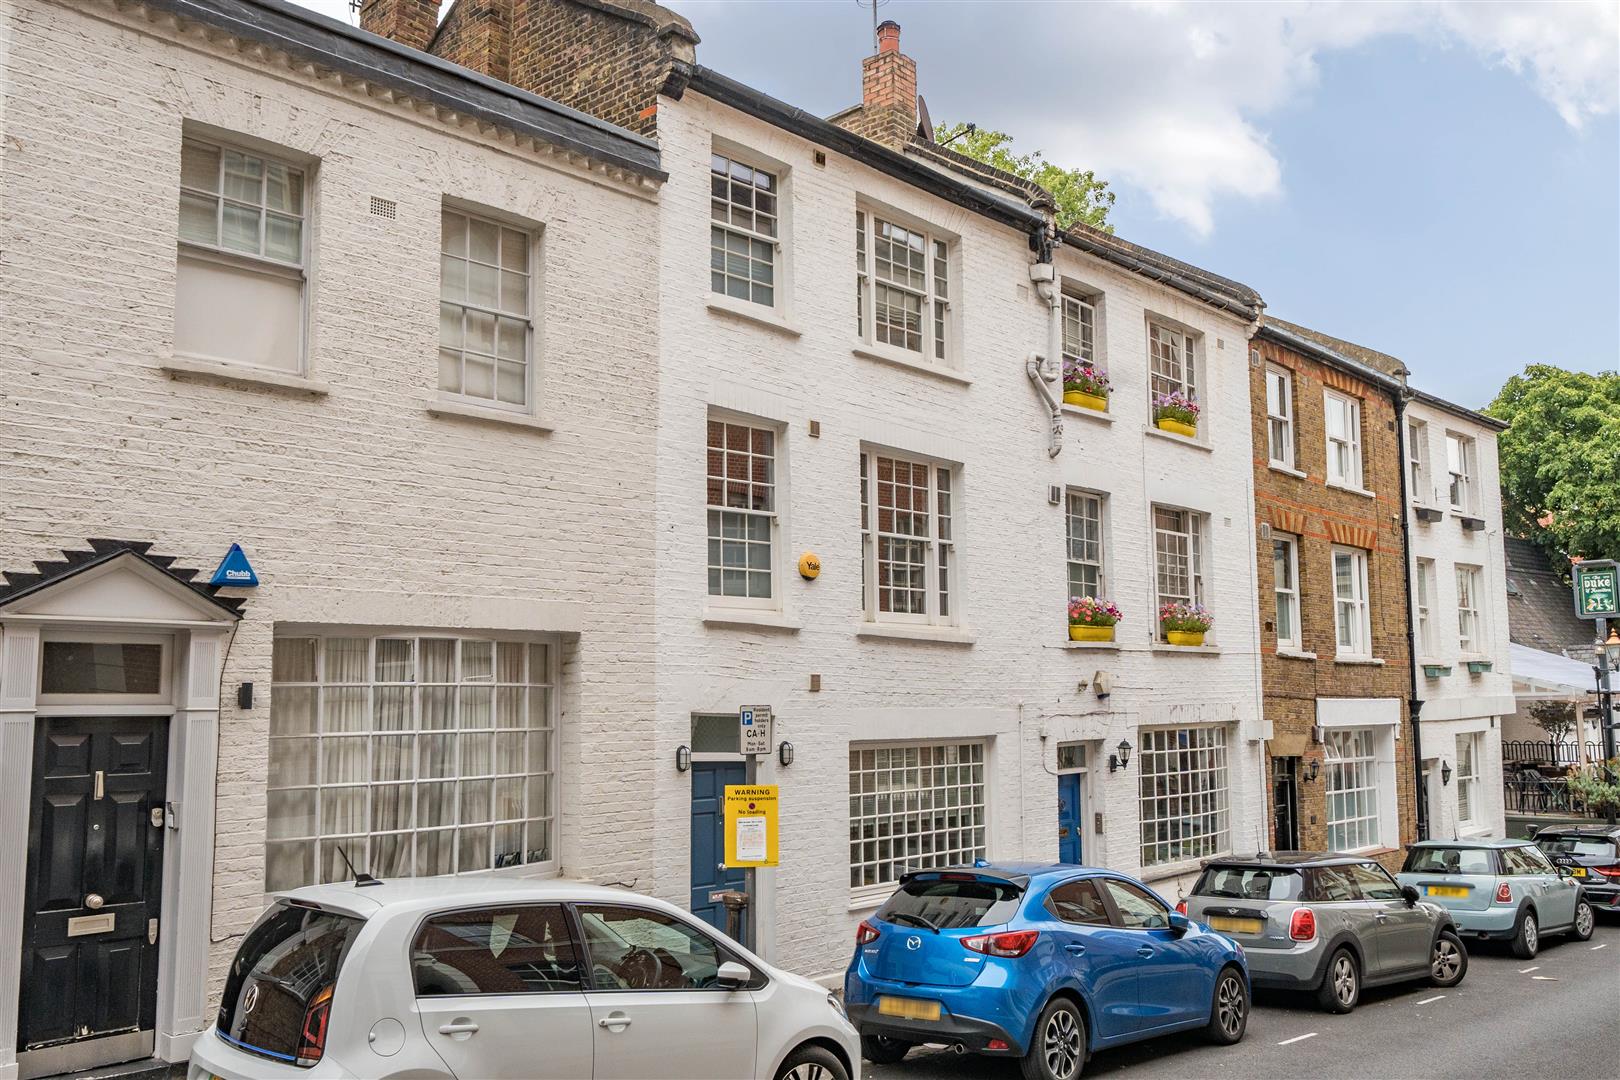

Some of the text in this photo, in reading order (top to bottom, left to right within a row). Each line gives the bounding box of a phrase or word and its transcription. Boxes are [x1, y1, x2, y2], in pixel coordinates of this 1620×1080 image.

[806, 561, 820, 570] Yale
[226, 569, 251, 577] Chubb
[744, 712, 752, 725] P
